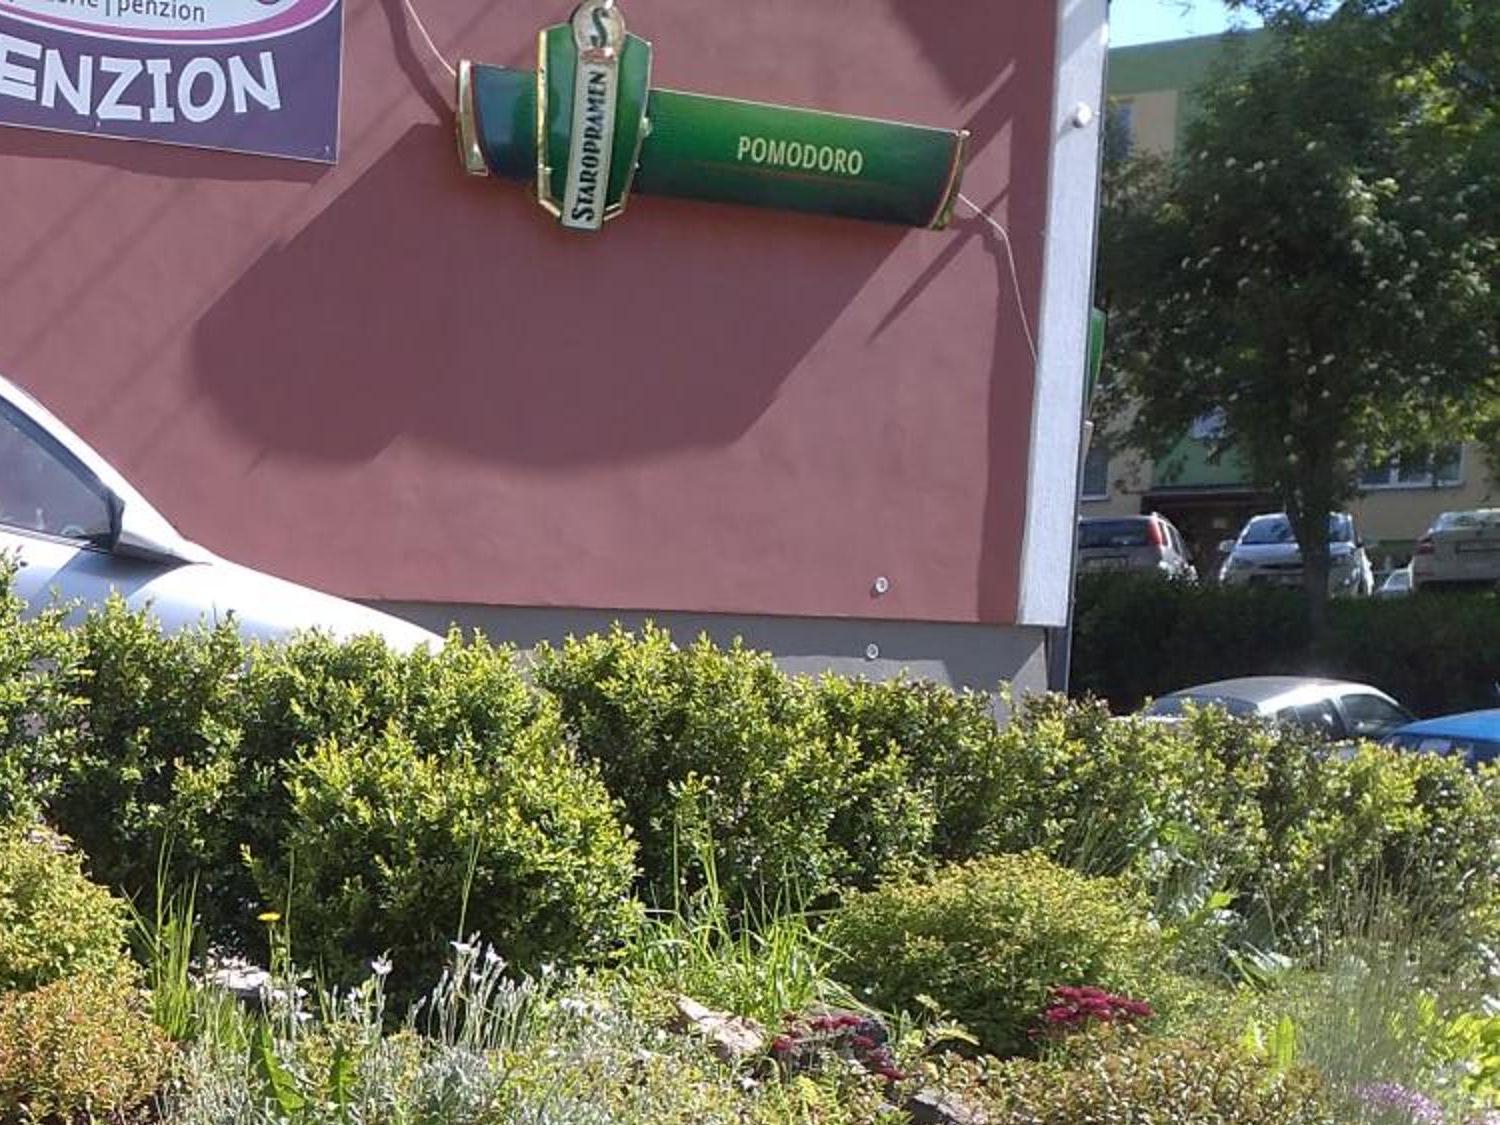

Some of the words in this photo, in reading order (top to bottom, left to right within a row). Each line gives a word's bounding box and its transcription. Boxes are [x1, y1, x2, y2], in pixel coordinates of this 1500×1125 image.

[117, 0, 205, 22] penzion
[571, 71, 607, 222] STAROPRAMEN
[737, 135, 864, 175] POMODORO
